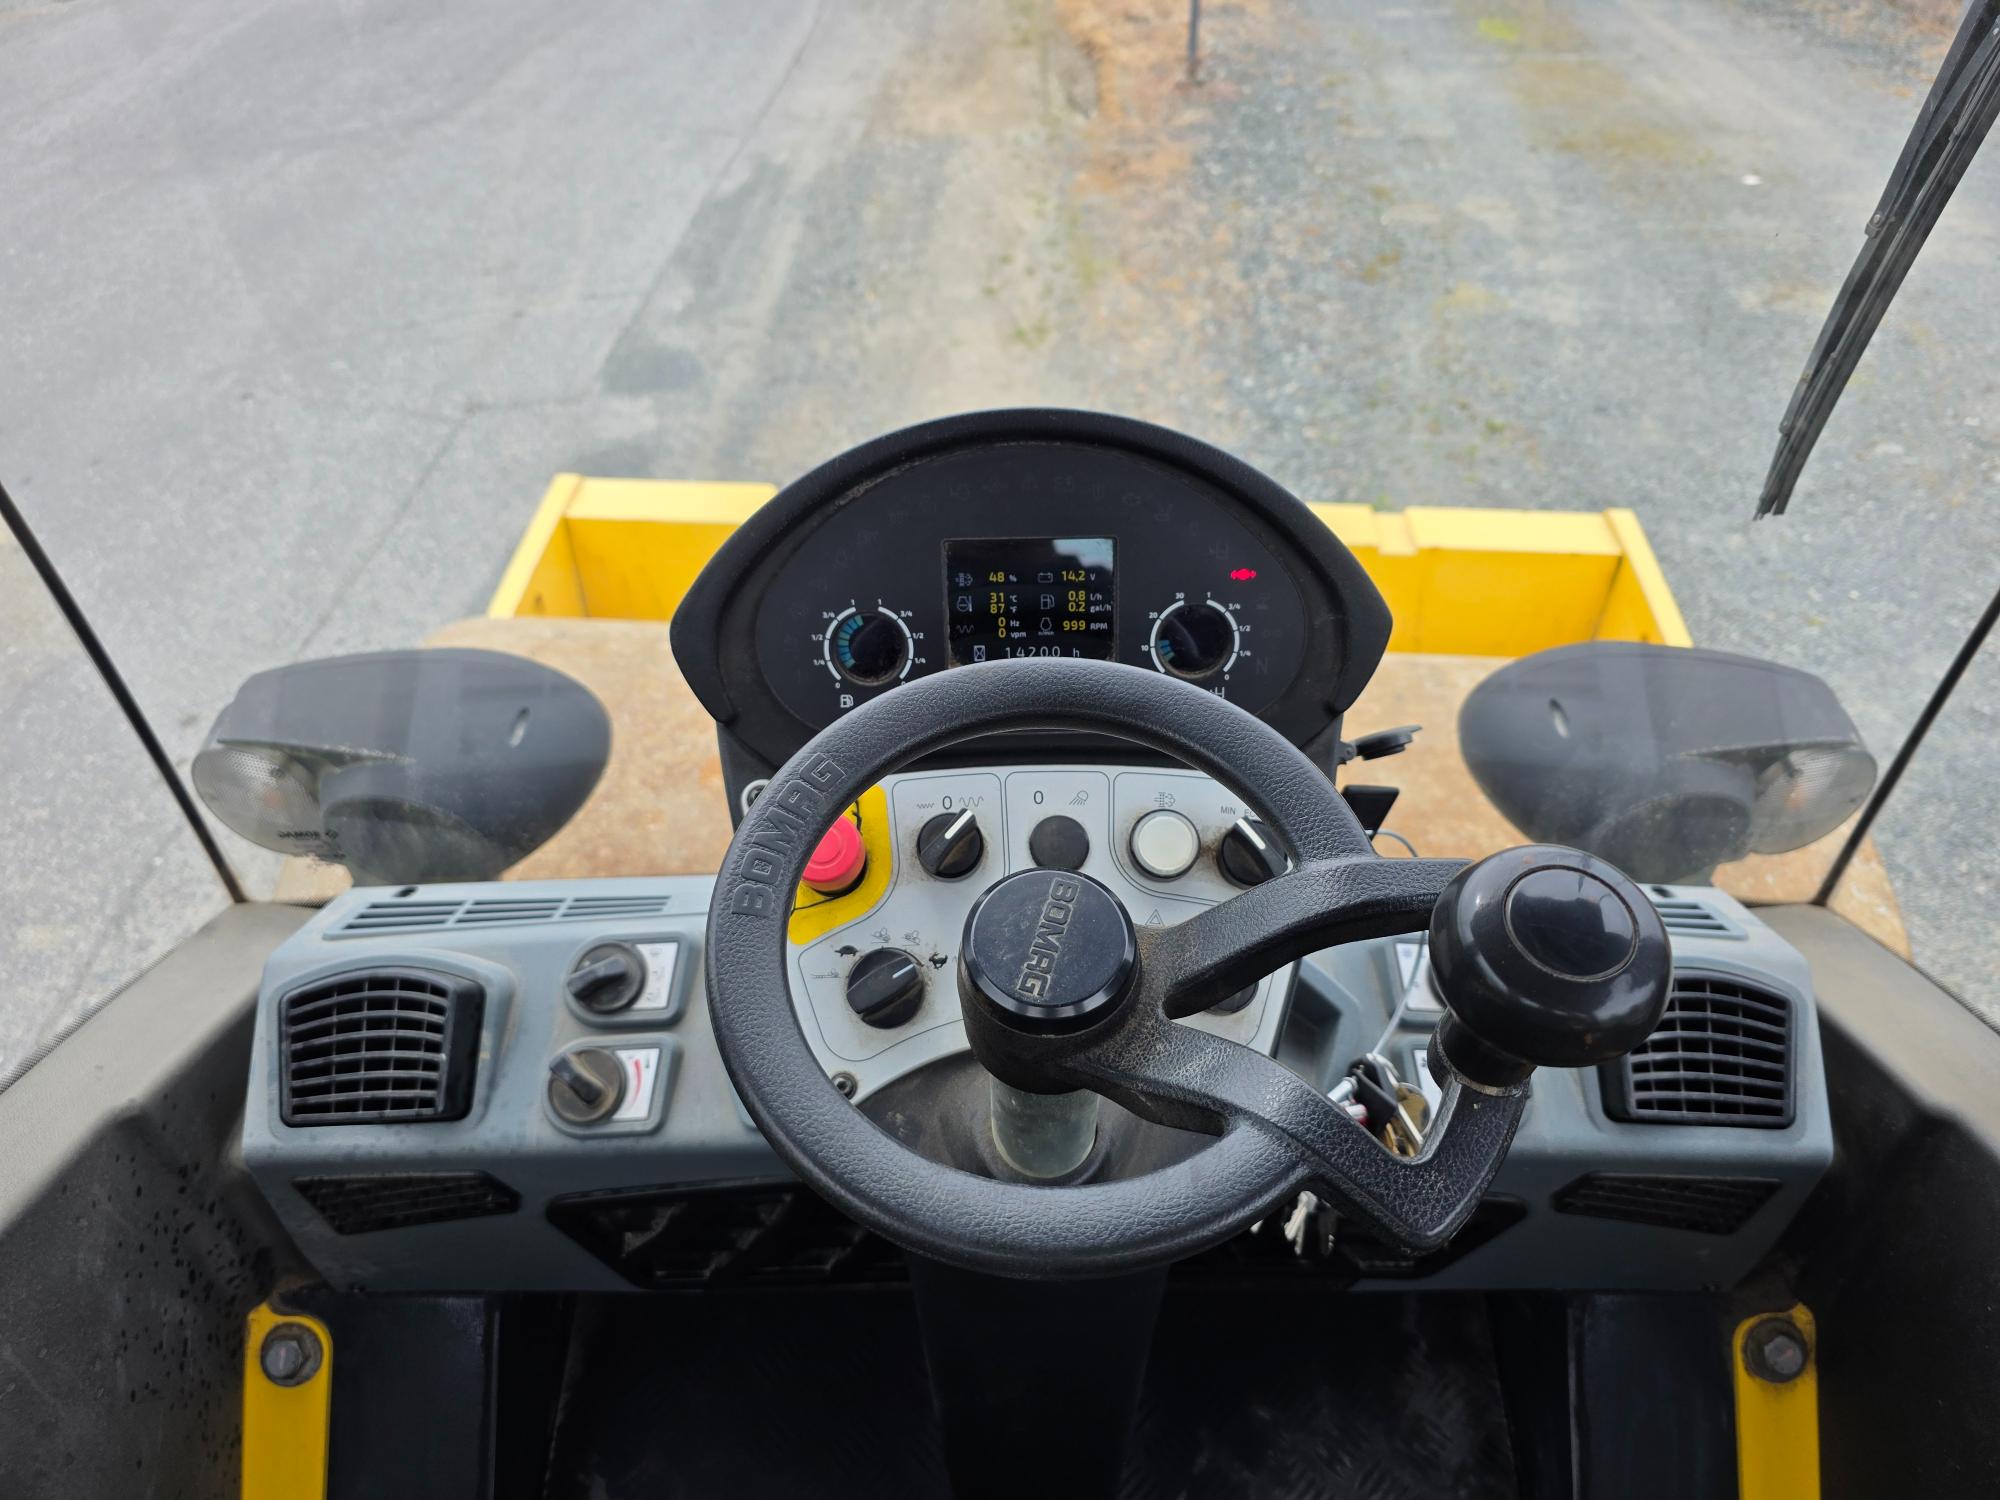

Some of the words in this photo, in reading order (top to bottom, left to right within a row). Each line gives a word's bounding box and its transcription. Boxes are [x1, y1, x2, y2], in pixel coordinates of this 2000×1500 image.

[989, 572, 1005, 582] 48
[990, 592, 1004, 603] 31
[990, 603, 1005, 614] 87
[1090, 604, 1112, 613] gal/h
[822, 611, 836, 619] 3/4
[998, 617, 1006, 627] 0
[1010, 619, 1020, 627] Hz
[1063, 620, 1086, 631] 999
[1090, 622, 1108, 630] RPM
[998, 628, 1006, 638] 0
[1010, 631, 1026, 639] vpm
[1141, 644, 1149, 652] 10
[942, 795, 952, 810] 0
[1033, 790, 1044, 805] 0
[1220, 806, 1236, 816] MIN
[731, 752, 847, 919] BOMAG
[1017, 877, 1081, 998] BOMAG
